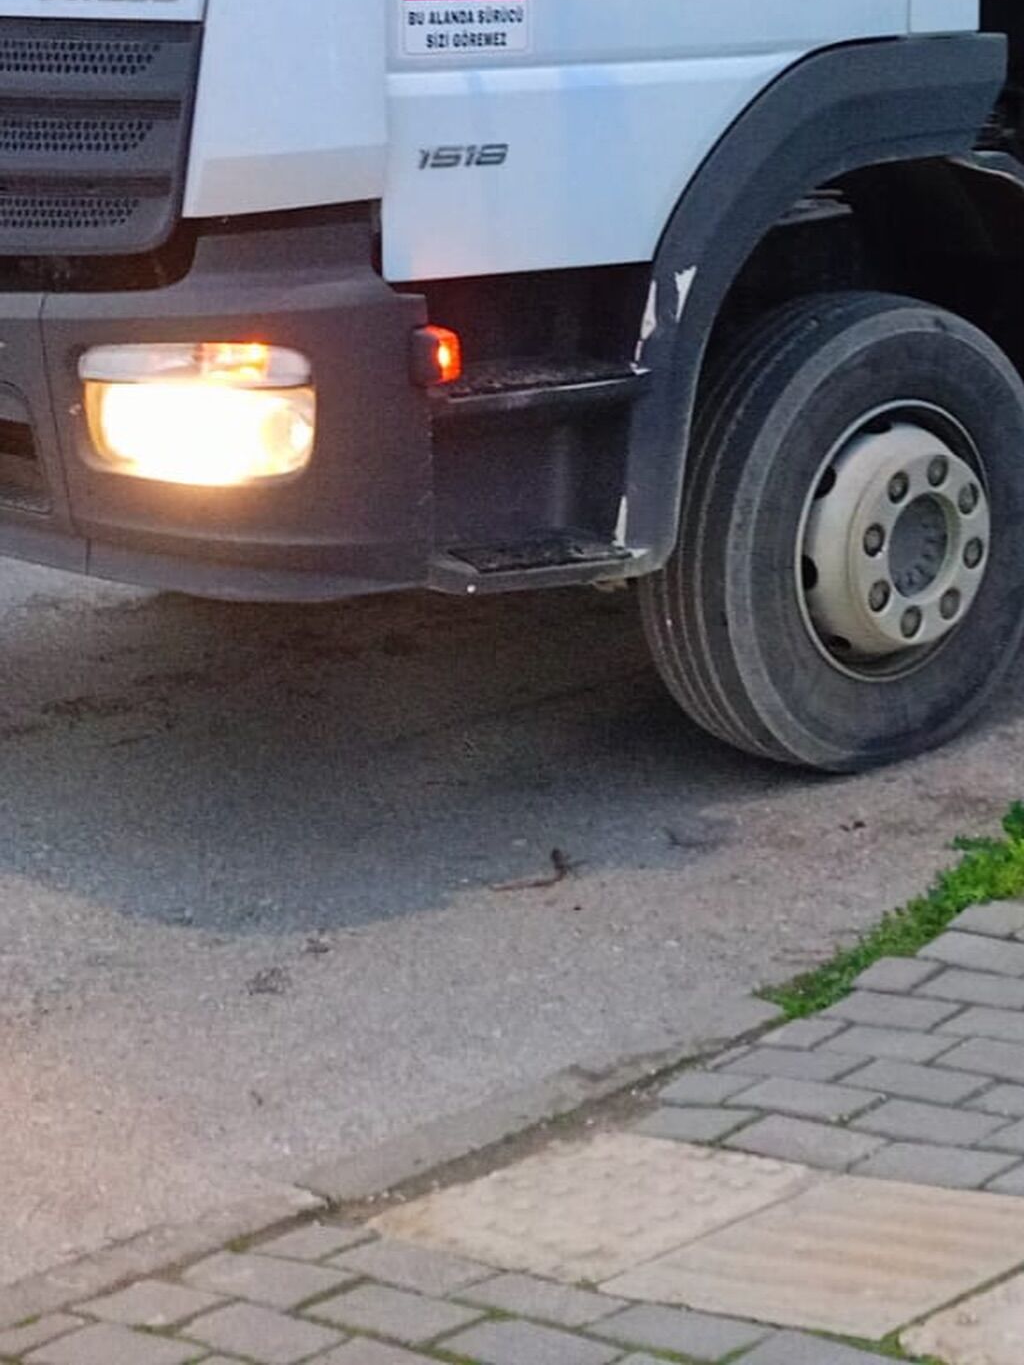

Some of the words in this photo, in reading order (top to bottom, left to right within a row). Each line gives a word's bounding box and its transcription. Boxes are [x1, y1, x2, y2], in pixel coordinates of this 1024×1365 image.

[407, 11, 425, 26] BU
[428, 9, 475, 26] ALANDA
[452, 29, 508, 48] GÖREMEZ
[418, 143, 509, 171] 1518
